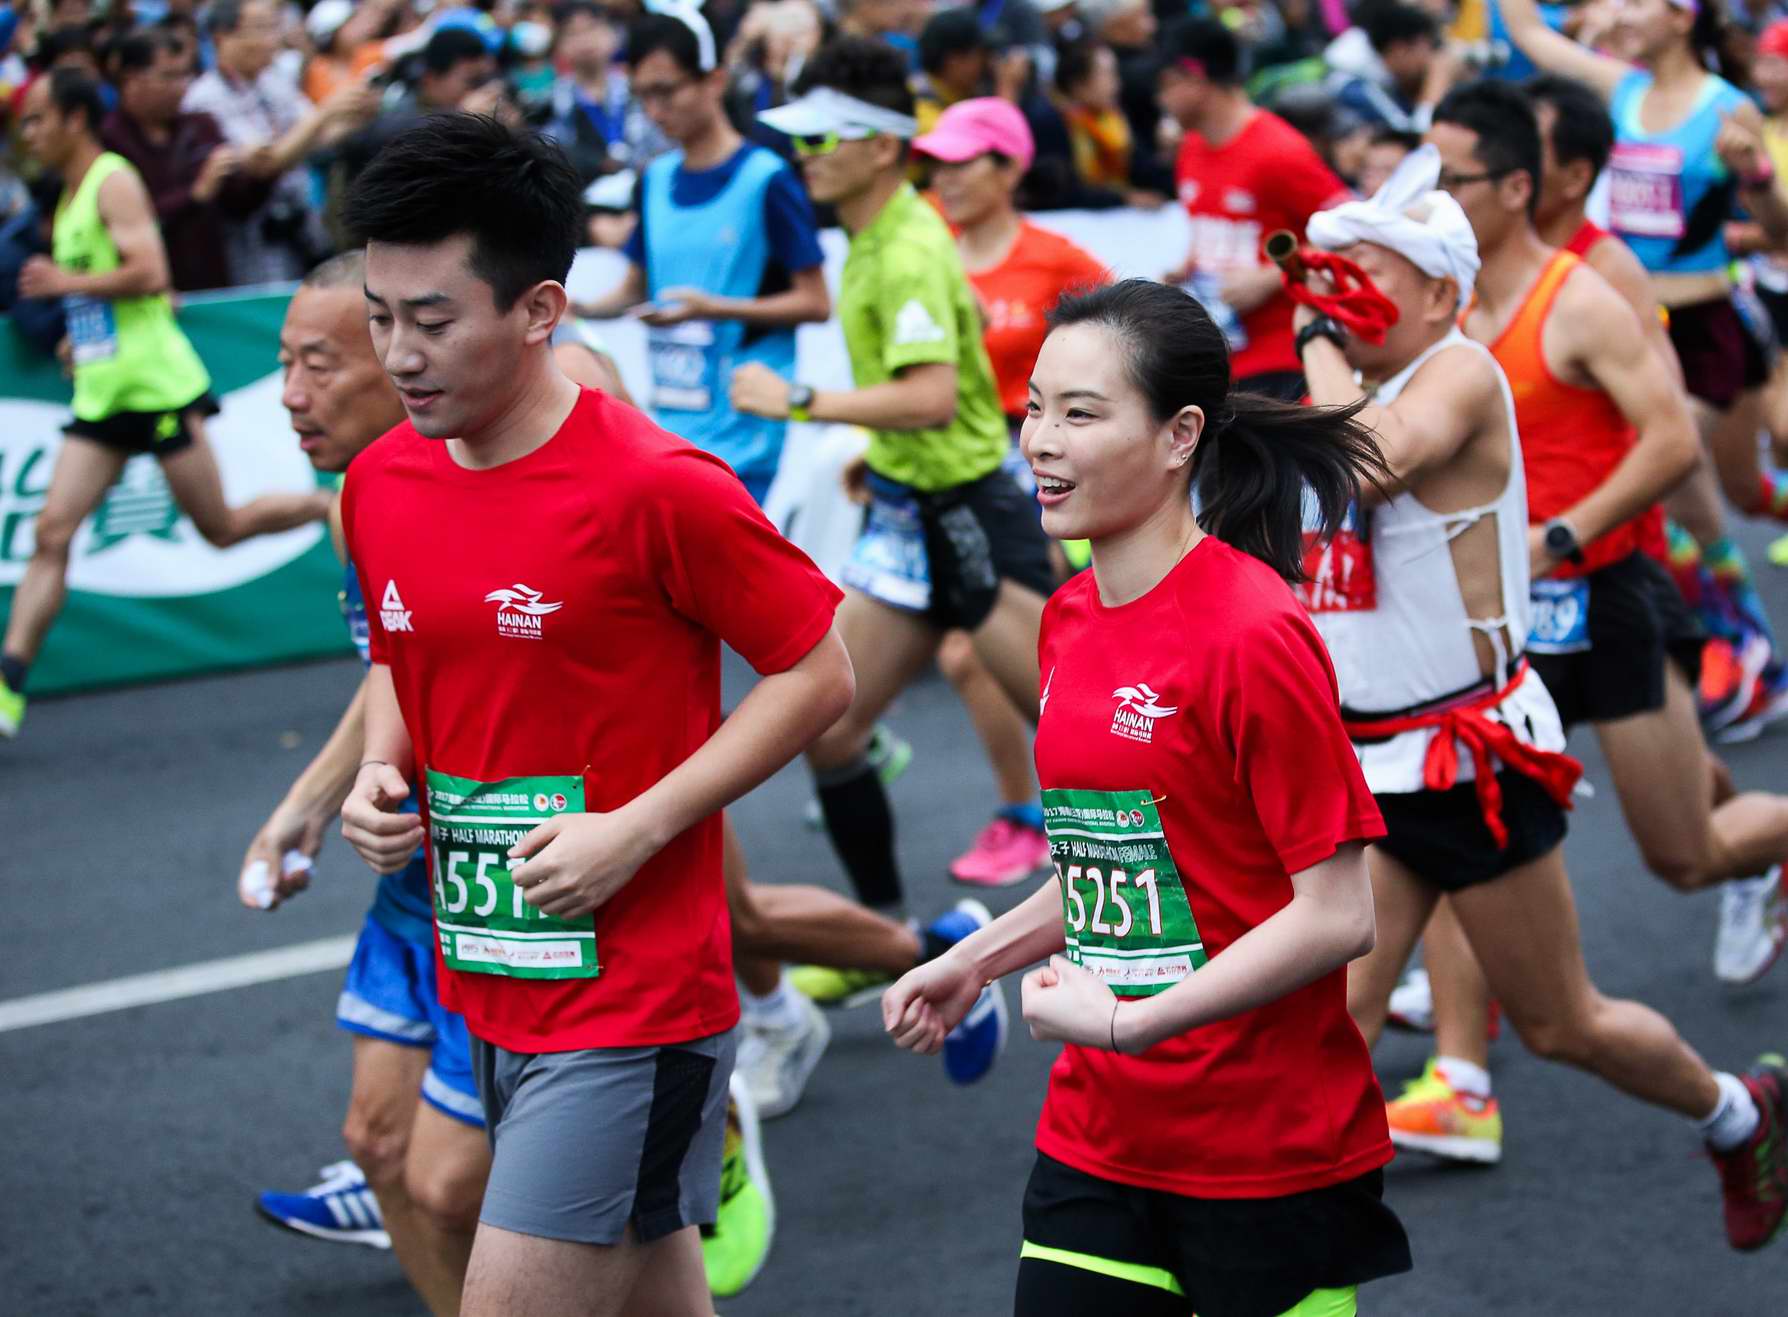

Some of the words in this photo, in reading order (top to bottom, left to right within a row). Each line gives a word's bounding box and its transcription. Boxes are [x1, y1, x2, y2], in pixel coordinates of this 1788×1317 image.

[497, 612, 542, 630] HAINAN
[1113, 708, 1155, 732] HAINAN
[452, 828, 473, 844] HALF
[1071, 841, 1087, 858] HALF
[433, 845, 549, 919] A557
[1054, 862, 1163, 937] 5251
